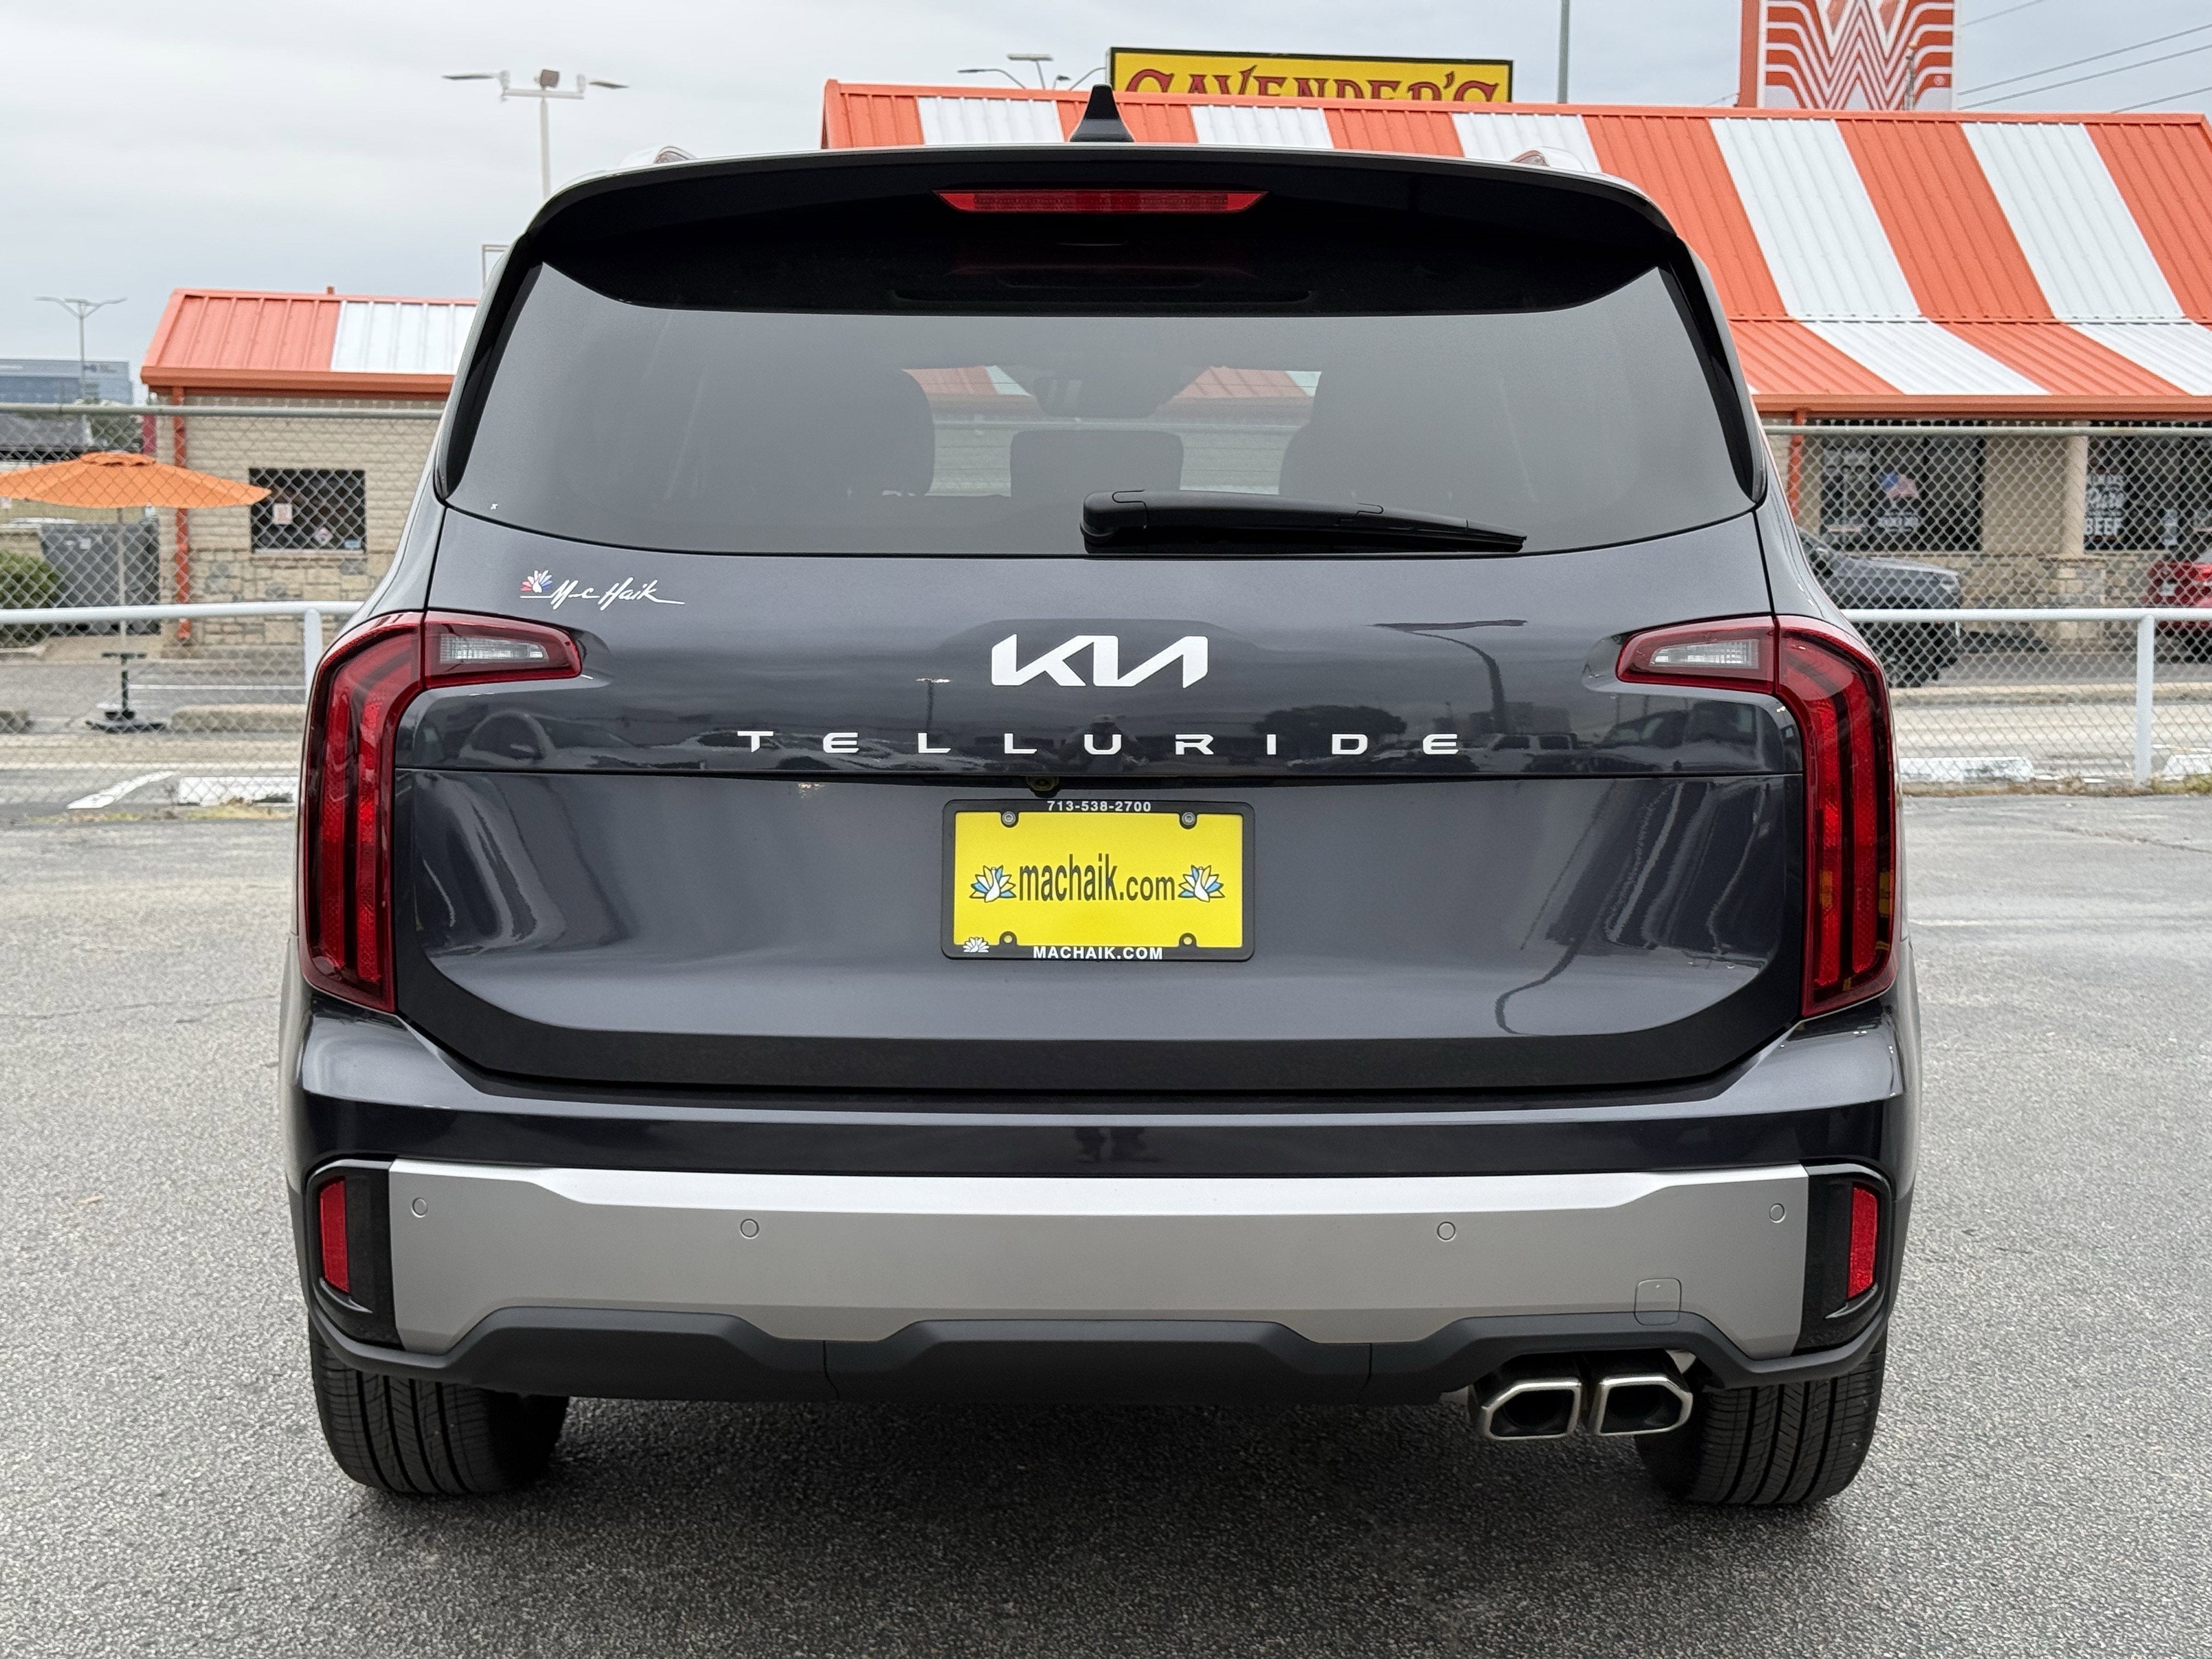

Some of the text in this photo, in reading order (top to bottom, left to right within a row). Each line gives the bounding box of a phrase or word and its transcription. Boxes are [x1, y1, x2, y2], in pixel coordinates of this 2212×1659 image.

[597, 577, 685, 611] Haik
[991, 634, 1208, 689] KIA
[737, 730, 1458, 755] TELLURIDE
[1047, 800, 1152, 812] 713-538-2700
[1019, 853, 1176, 901] machaik.com
[1032, 946, 1163, 960] MACHAIK.COM
